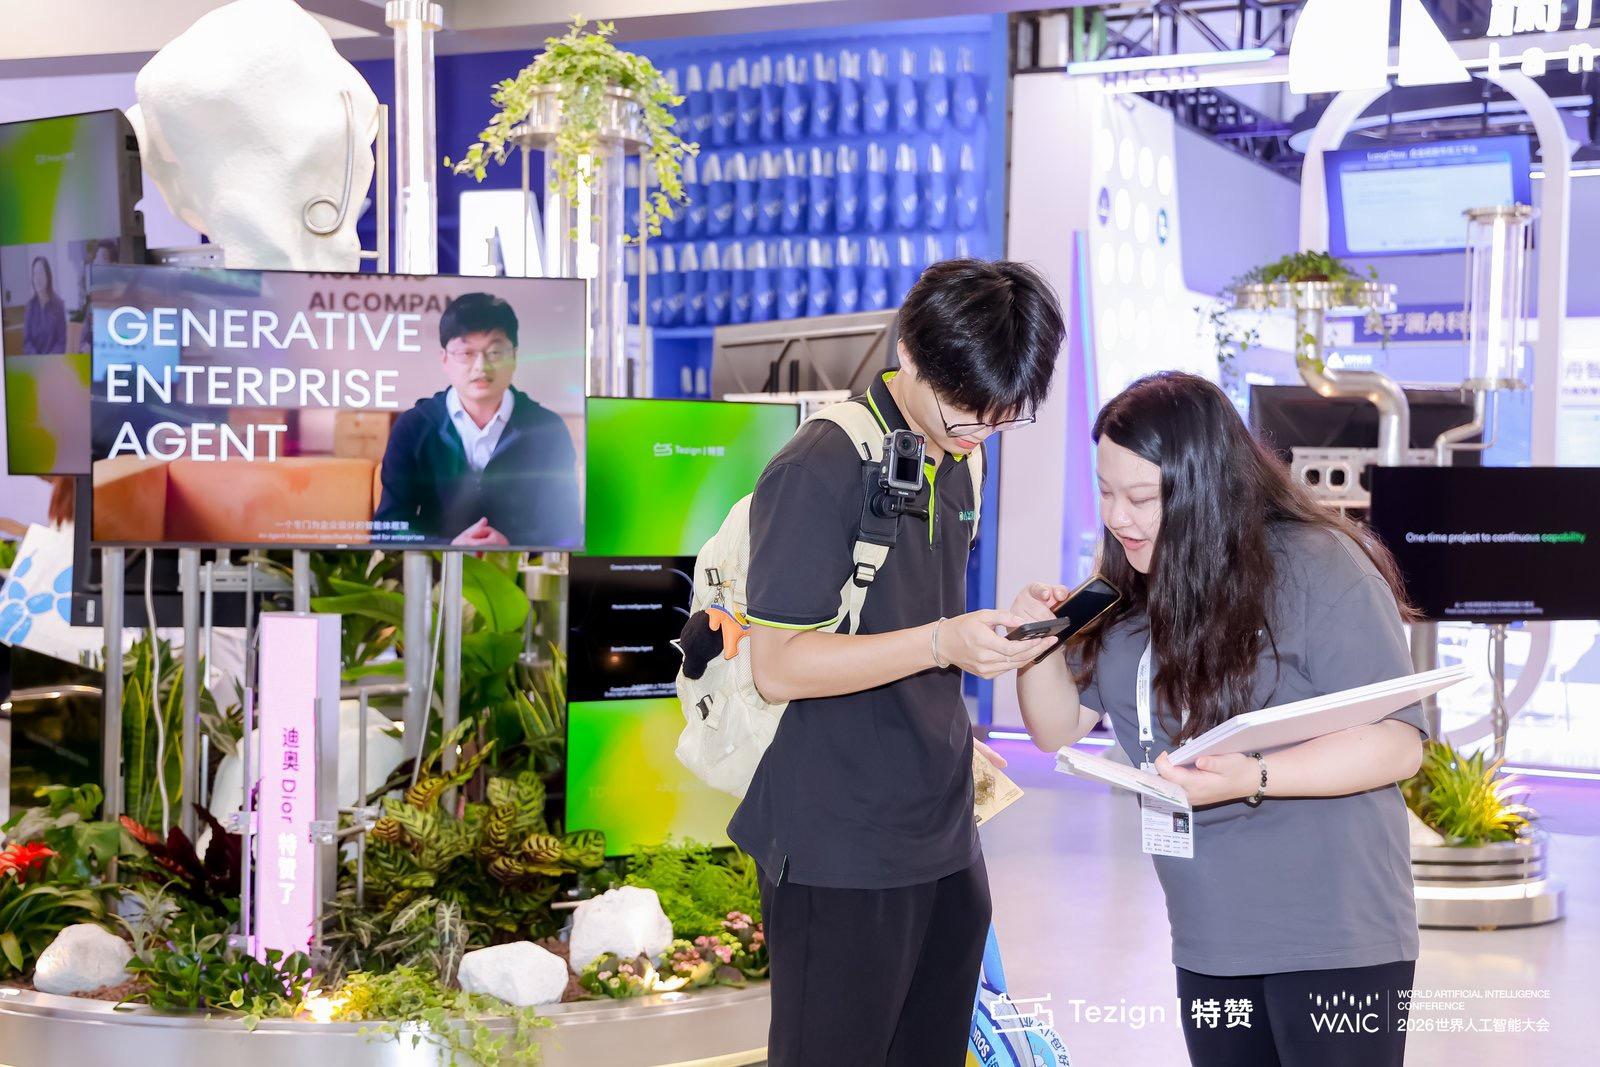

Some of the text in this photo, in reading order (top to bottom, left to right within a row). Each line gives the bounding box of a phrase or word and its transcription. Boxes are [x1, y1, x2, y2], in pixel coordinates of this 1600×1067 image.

[308, 291, 335, 311] AI
[107, 305, 421, 352] GENERATIVE
[106, 363, 400, 409] ENTERPRISE
[107, 420, 288, 463] AGENT
[282, 727, 300, 772] 迪奥
[281, 778, 297, 824] Dior
